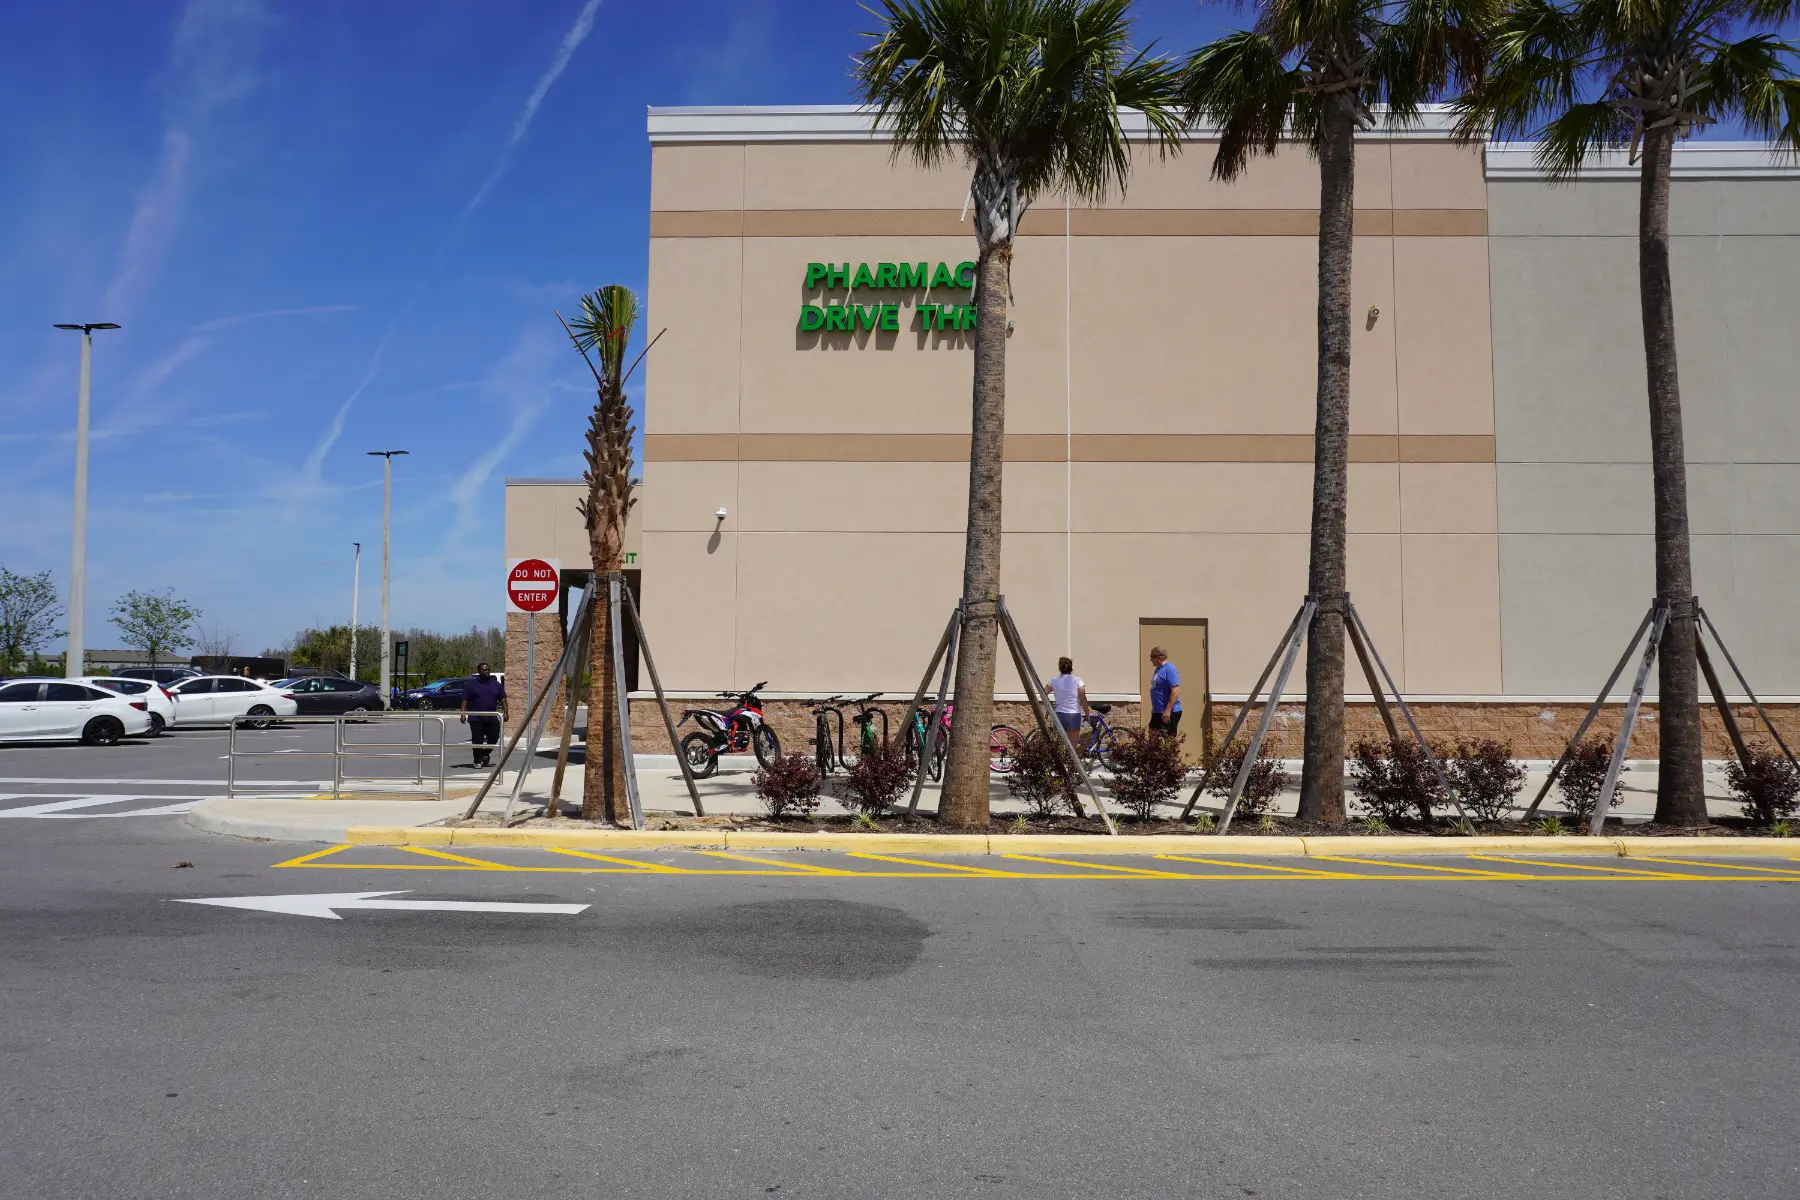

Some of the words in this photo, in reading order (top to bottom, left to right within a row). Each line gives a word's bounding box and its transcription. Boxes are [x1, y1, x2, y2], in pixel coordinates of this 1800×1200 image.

[807, 261, 976, 289] PHARMAC
[801, 304, 899, 332] DRIVE
[916, 304, 977, 332] THR
[624, 552, 637, 564] IT
[515, 569, 529, 578] DO
[533, 569, 552, 578] NOT
[518, 592, 548, 602] ENTER
